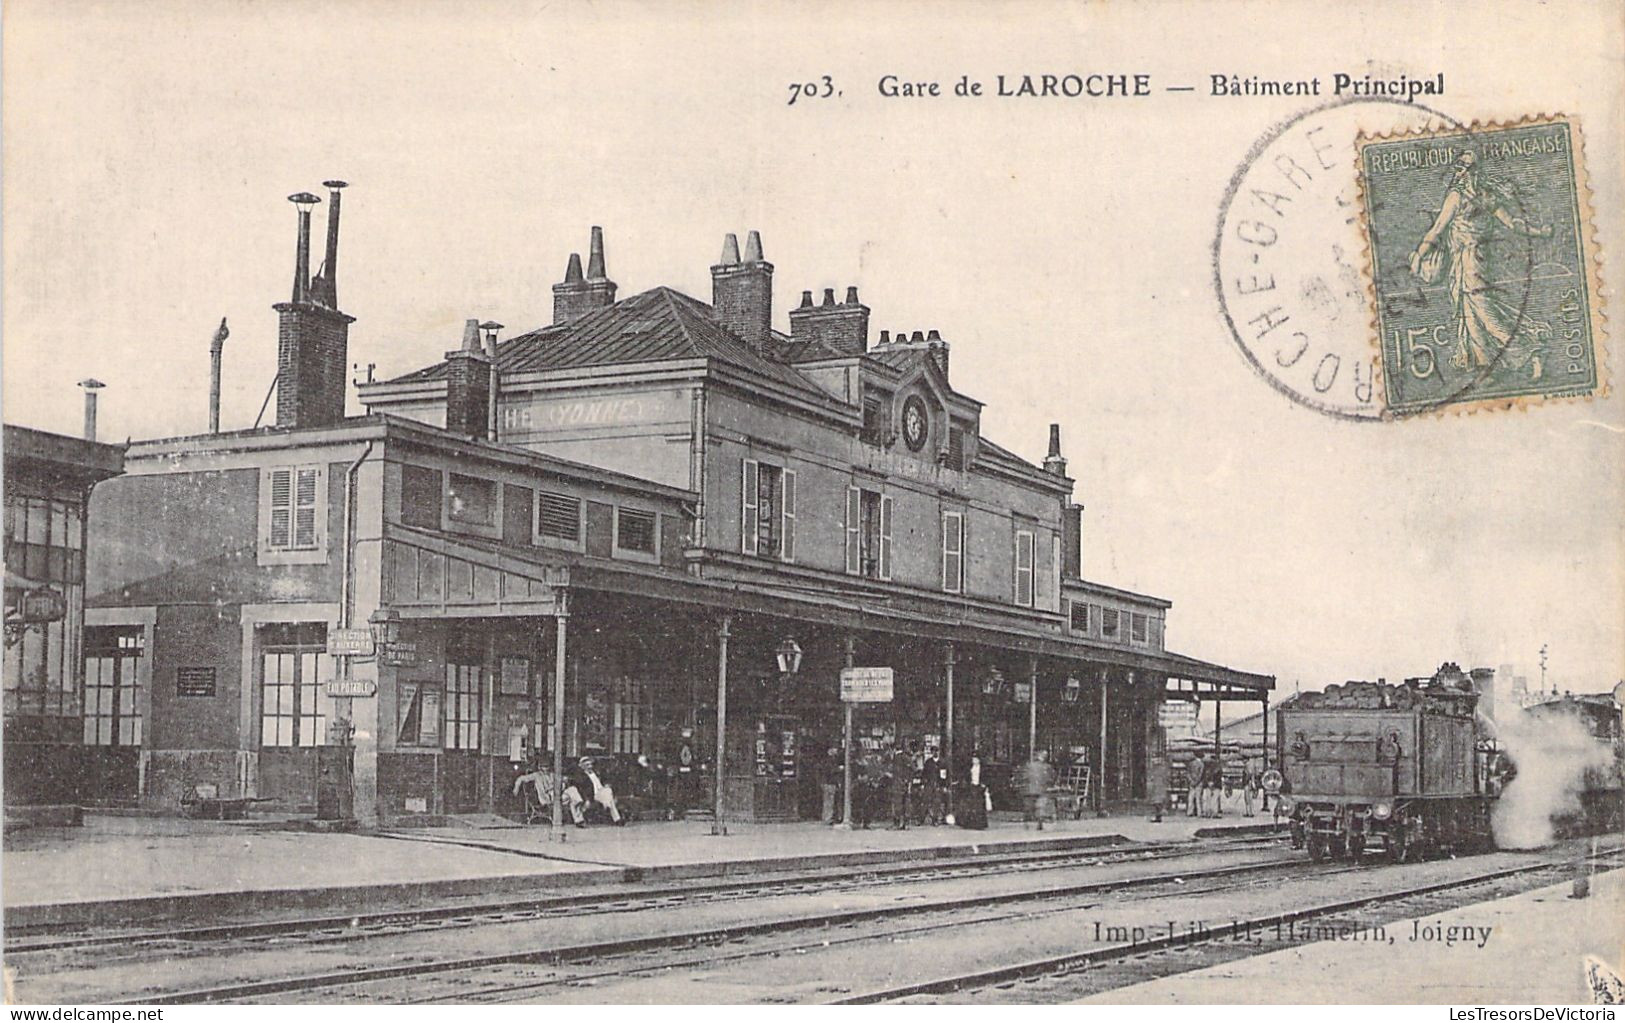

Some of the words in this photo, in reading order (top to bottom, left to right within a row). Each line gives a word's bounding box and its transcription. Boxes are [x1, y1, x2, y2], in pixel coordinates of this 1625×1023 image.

[787, 75, 844, 106] 703.
[878, 75, 941, 98] Gare
[954, 75, 983, 97] de
[997, 74, 1151, 98] LAROCHE
[1210, 73, 1321, 97] Bâtiment
[1333, 72, 1444, 106] Principal
[327, 682, 340, 694] EAU
[1408, 920, 1492, 947] Joigny
